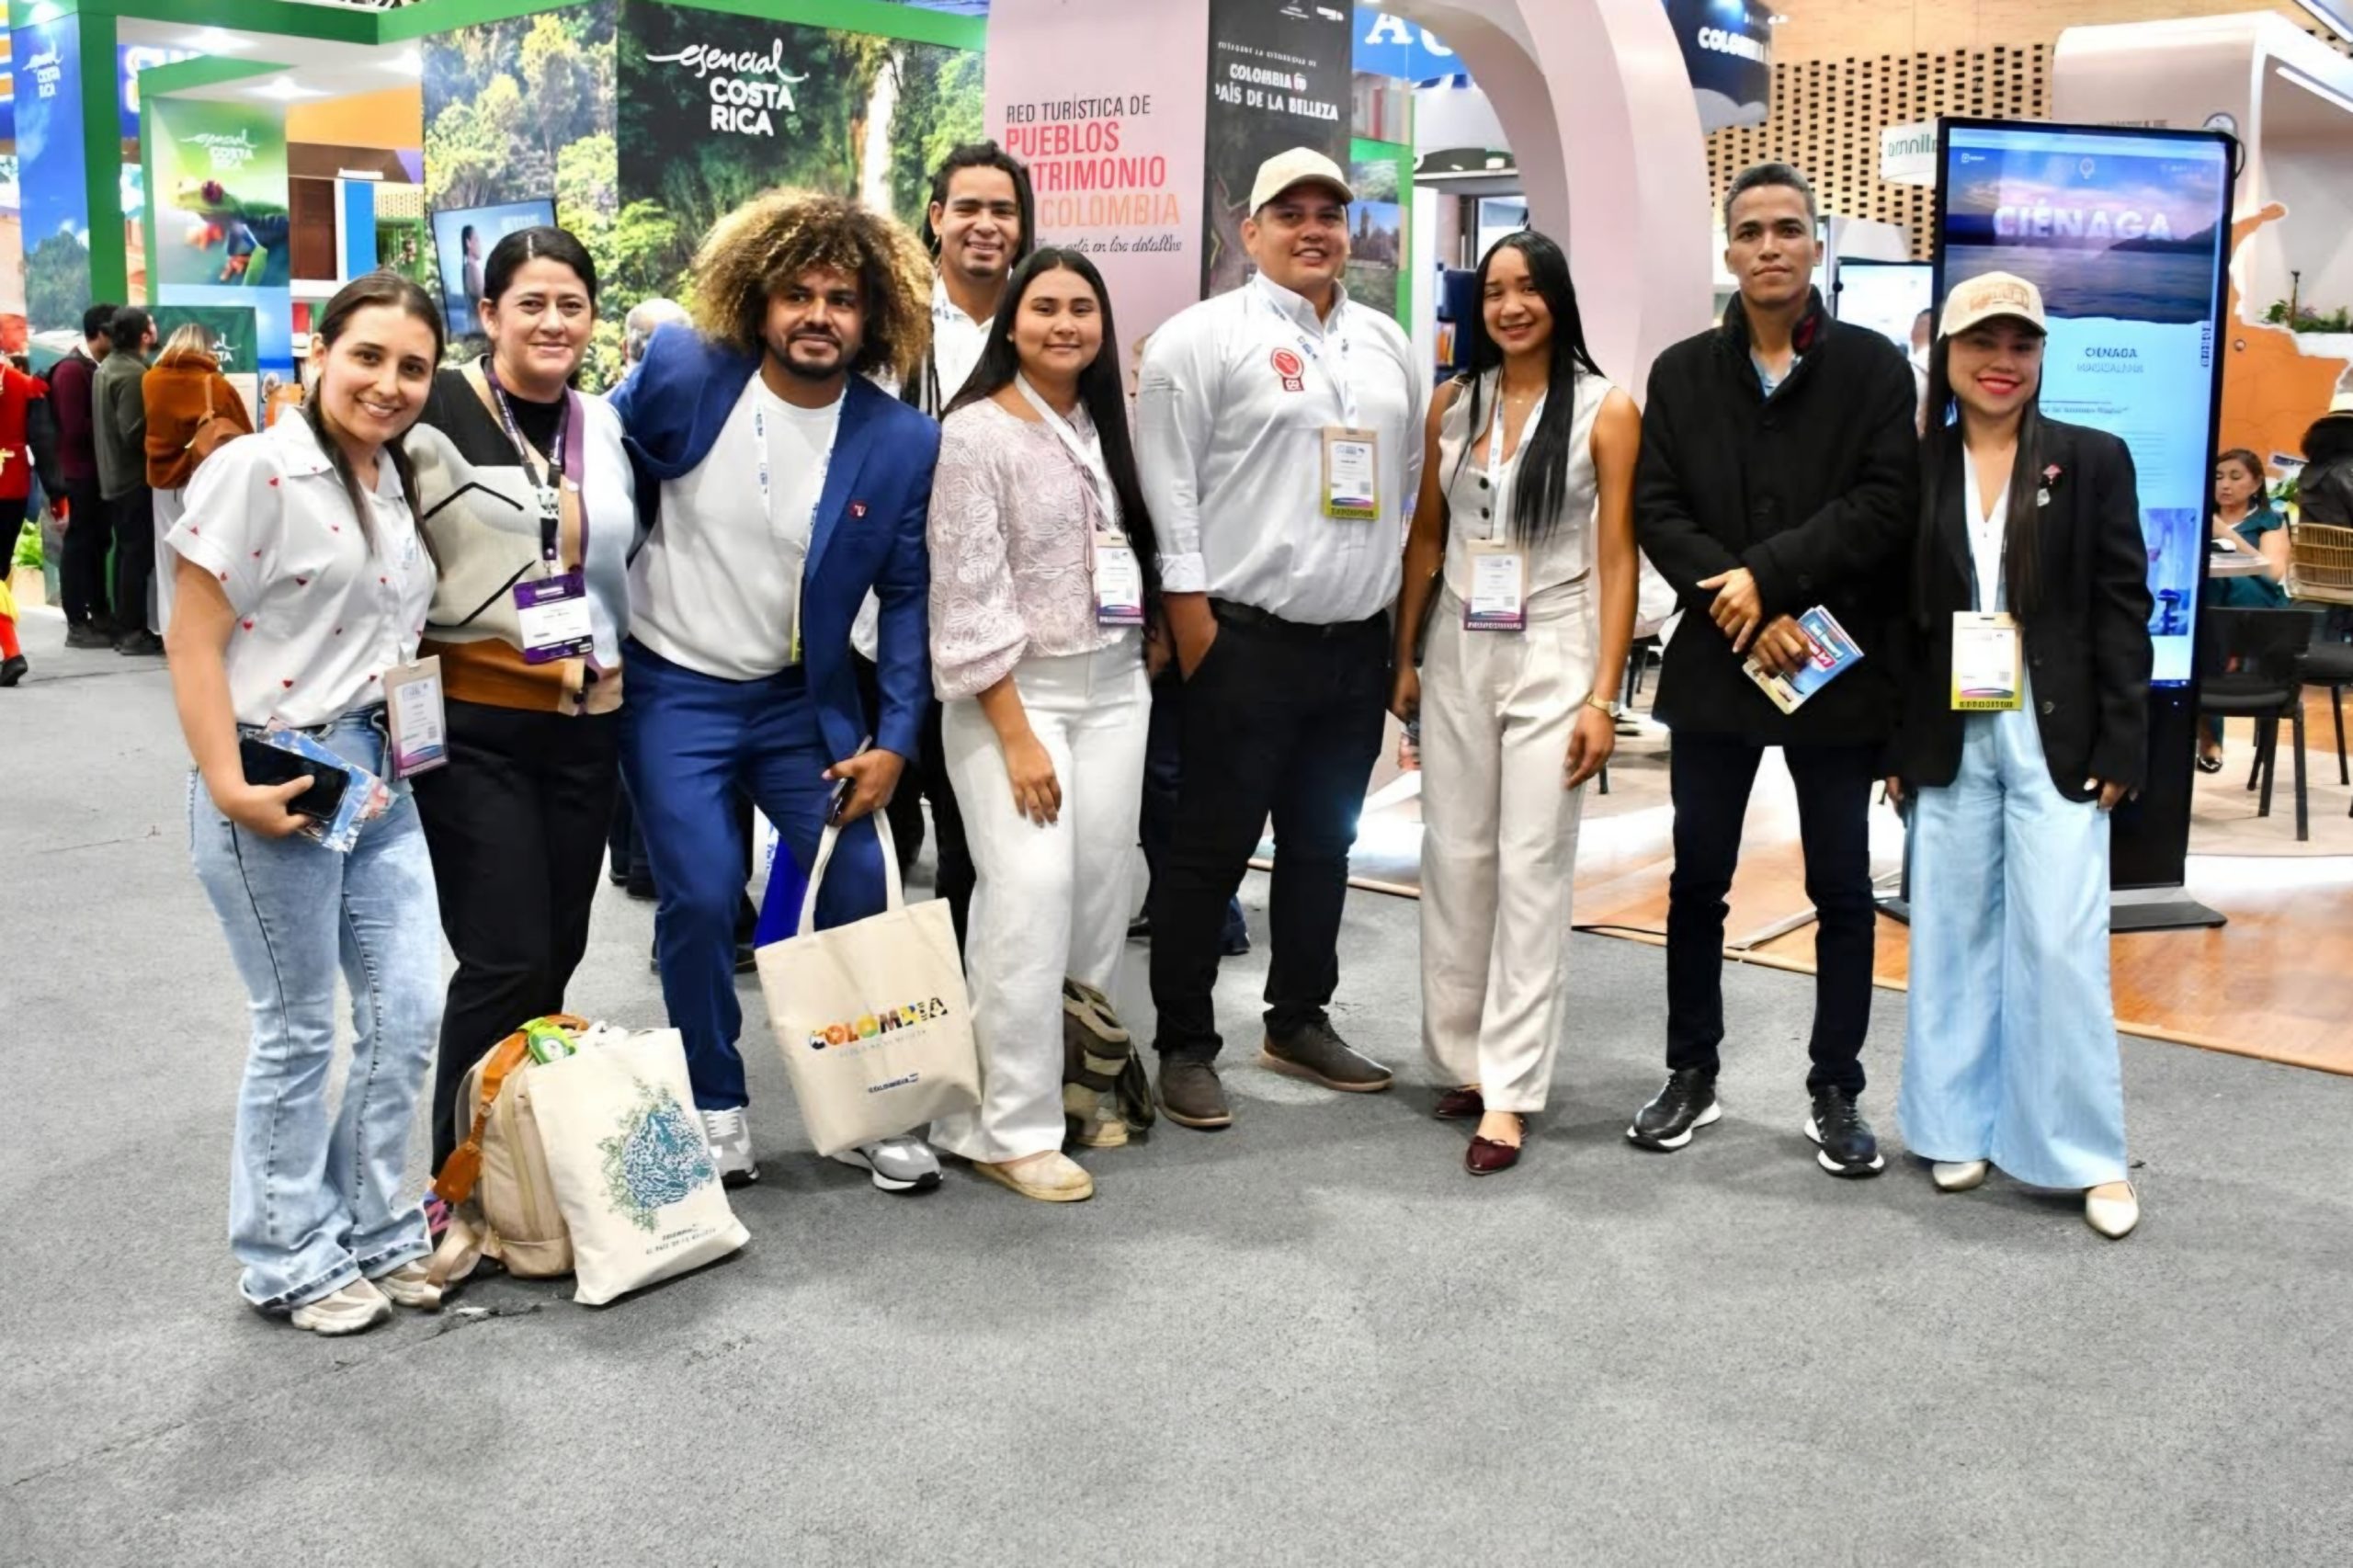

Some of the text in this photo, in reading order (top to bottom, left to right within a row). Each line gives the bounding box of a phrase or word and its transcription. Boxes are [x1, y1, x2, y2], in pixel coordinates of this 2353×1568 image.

[646, 38, 810, 78] esencial
[710, 76, 795, 111] COSTA
[1230, 63, 1292, 89] COLOMBIA
[710, 104, 774, 137] RICA
[1006, 94, 1151, 123] RED TURÍSTICA DE
[1246, 89, 1264, 108] DE
[1267, 94, 1284, 111] LA
[1289, 97, 1338, 120] BELLEZA
[1006, 121, 1120, 157] PUEBLOS
[1026, 155, 1165, 192] TRIMONIO
[1041, 194, 1180, 228] COLOMBIA
[1993, 198, 2173, 241] CIÉNAGA
[809, 997, 949, 1050] COLOMBIA
